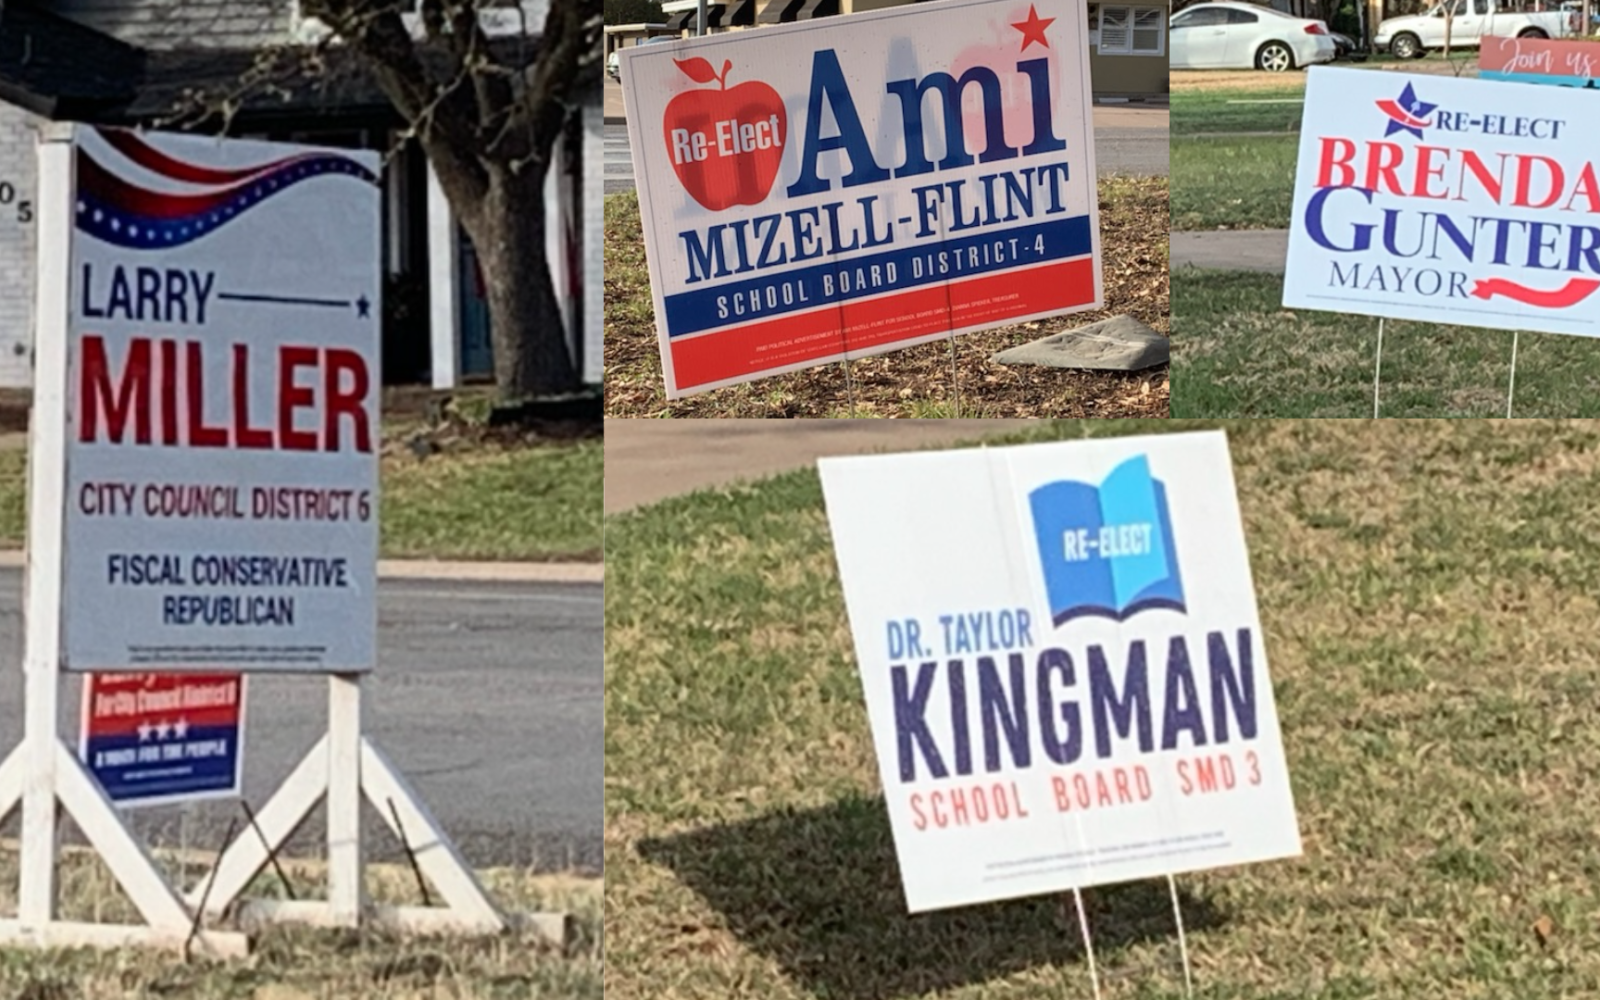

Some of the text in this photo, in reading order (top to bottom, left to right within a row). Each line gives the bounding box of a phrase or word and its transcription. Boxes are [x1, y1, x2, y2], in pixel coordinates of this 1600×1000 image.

[1499, 38, 1598, 80] Join us
[671, 114, 782, 165] Re-Elect
[787, 48, 1067, 198] Ami
[1435, 110, 1566, 141] RE-ELECT
[1313, 136, 1600, 214] BRENDA
[679, 162, 1070, 285] MIZELL-FLINT
[1304, 184, 1600, 276] GUNTER
[83, 263, 215, 325] LARRY
[717, 233, 1046, 320] SCHOOL BOARD DISTRICT-4
[1328, 260, 1469, 299] MAYOR
[79, 334, 373, 454] MILLER
[79, 481, 370, 522] CITY COUNCIL DISTRICT 6
[108, 554, 347, 588] FISCAL CONSERVATIVE
[1063, 523, 1152, 562] RE-ELECT
[162, 595, 294, 627] REPUBLICAN
[886, 608, 1035, 661] DR. TAYLOR
[890, 627, 1259, 784] KINGMAN
[909, 751, 1263, 832] SCHOOL BOARD SMD 3
